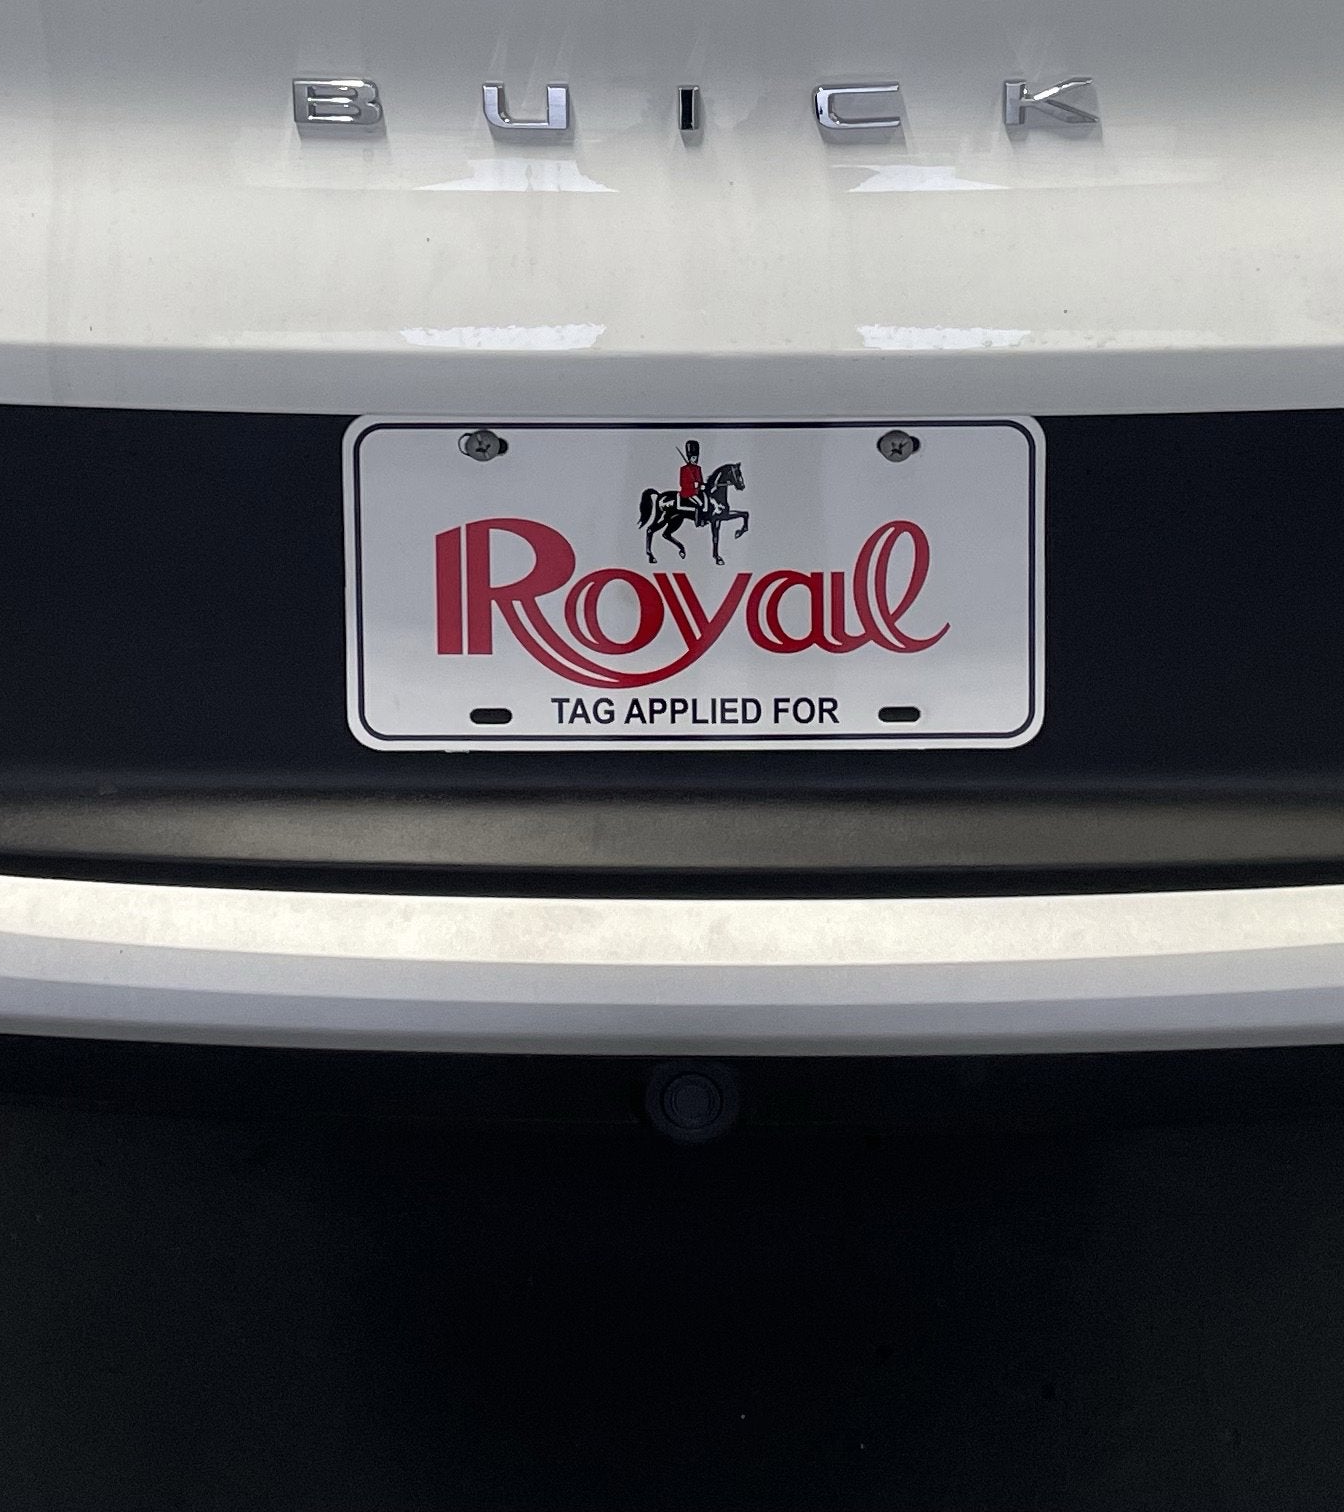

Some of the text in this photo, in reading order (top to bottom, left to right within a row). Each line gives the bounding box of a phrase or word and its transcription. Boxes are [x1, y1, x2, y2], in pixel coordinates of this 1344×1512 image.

[292, 77, 1099, 130] BUICK
[435, 517, 950, 689] Royal
[551, 696, 840, 724] TAG APPLIED FOR
